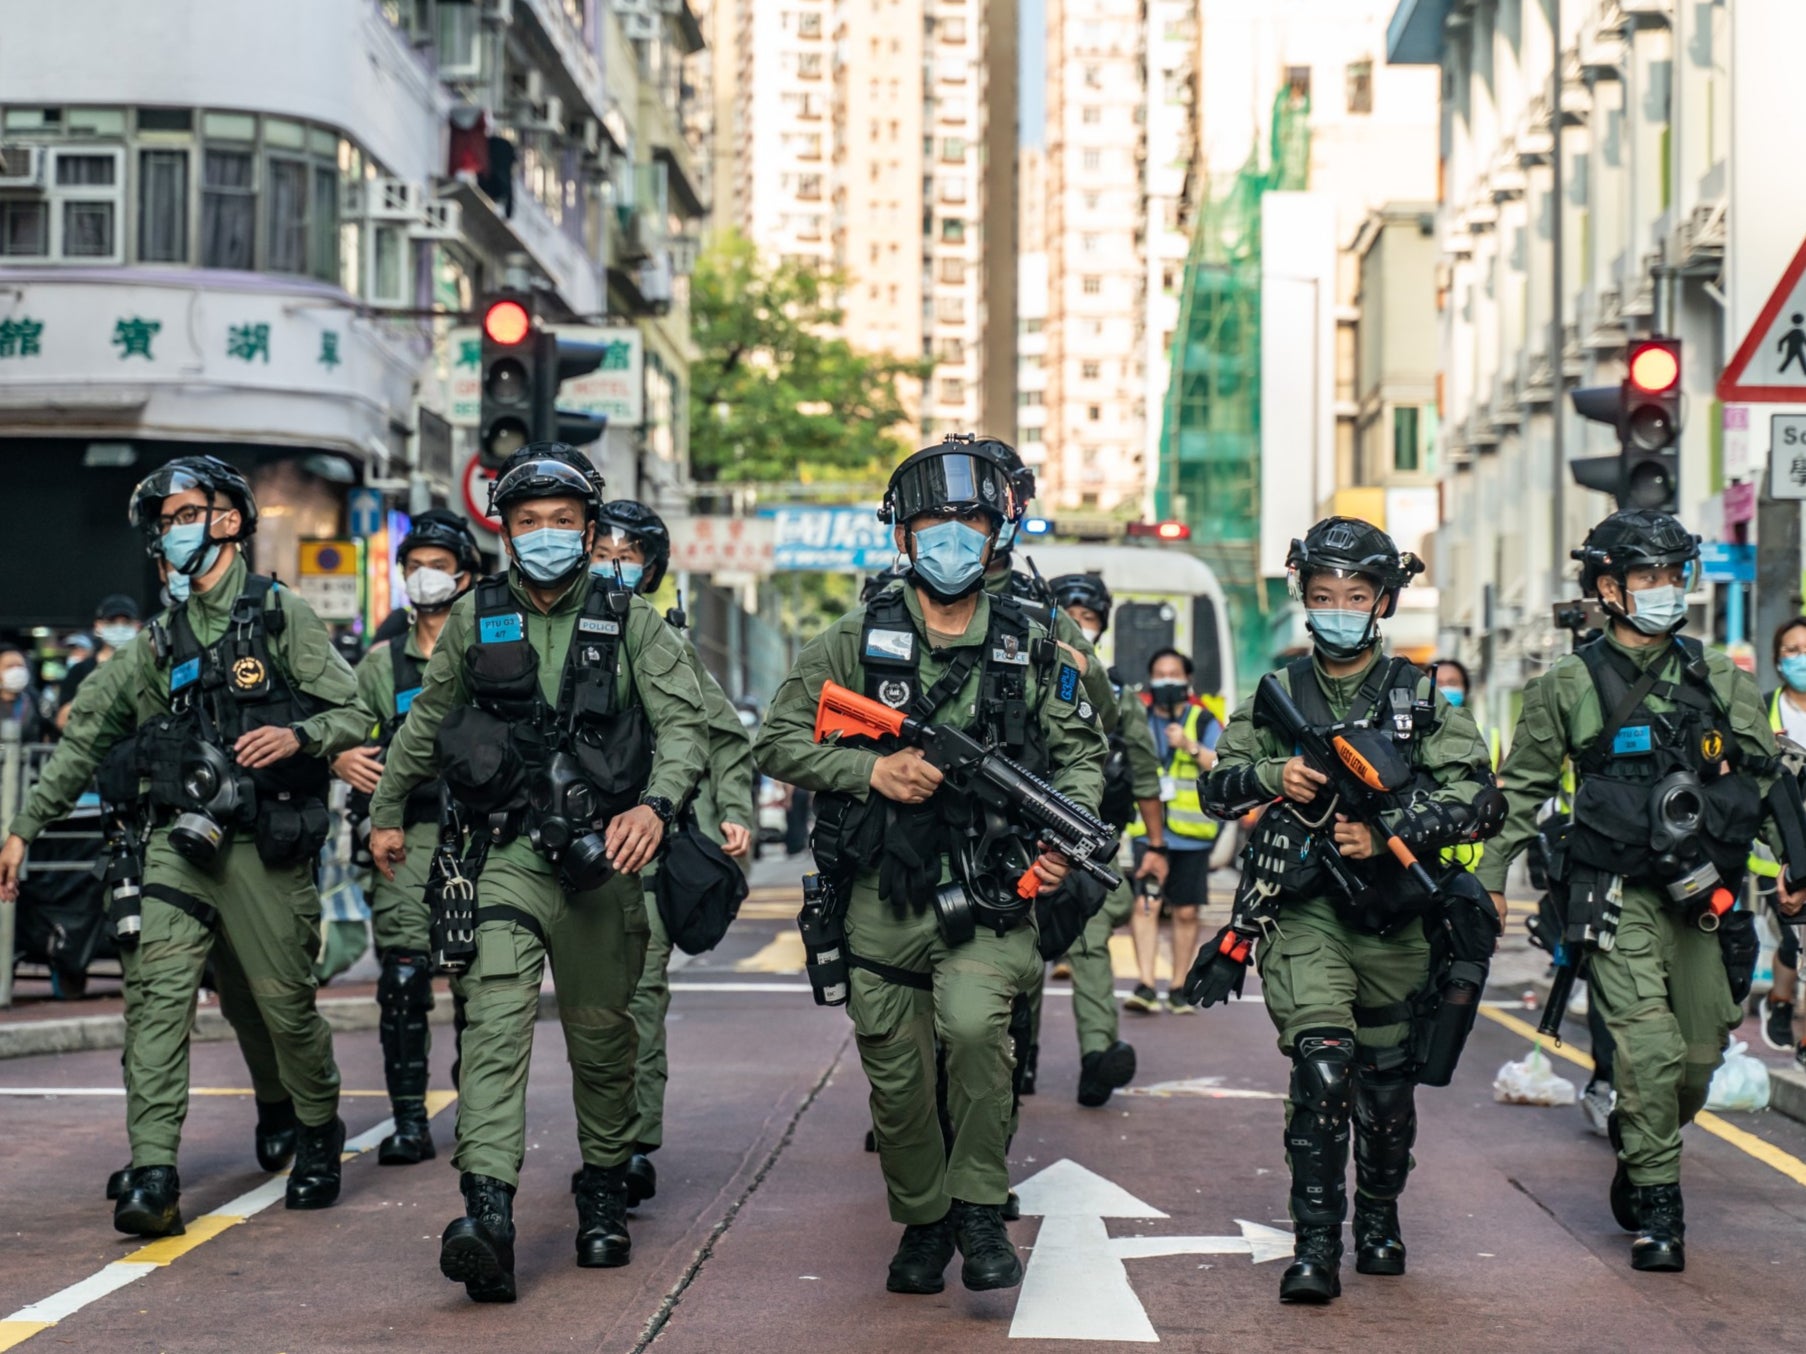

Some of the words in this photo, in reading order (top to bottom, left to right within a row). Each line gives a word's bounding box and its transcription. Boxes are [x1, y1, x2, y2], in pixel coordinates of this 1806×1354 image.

[583, 621, 617, 632] POLICE
[995, 651, 1026, 662] POCE
[1340, 745, 1353, 763] LESS
[1350, 756, 1368, 779] LETHAL
